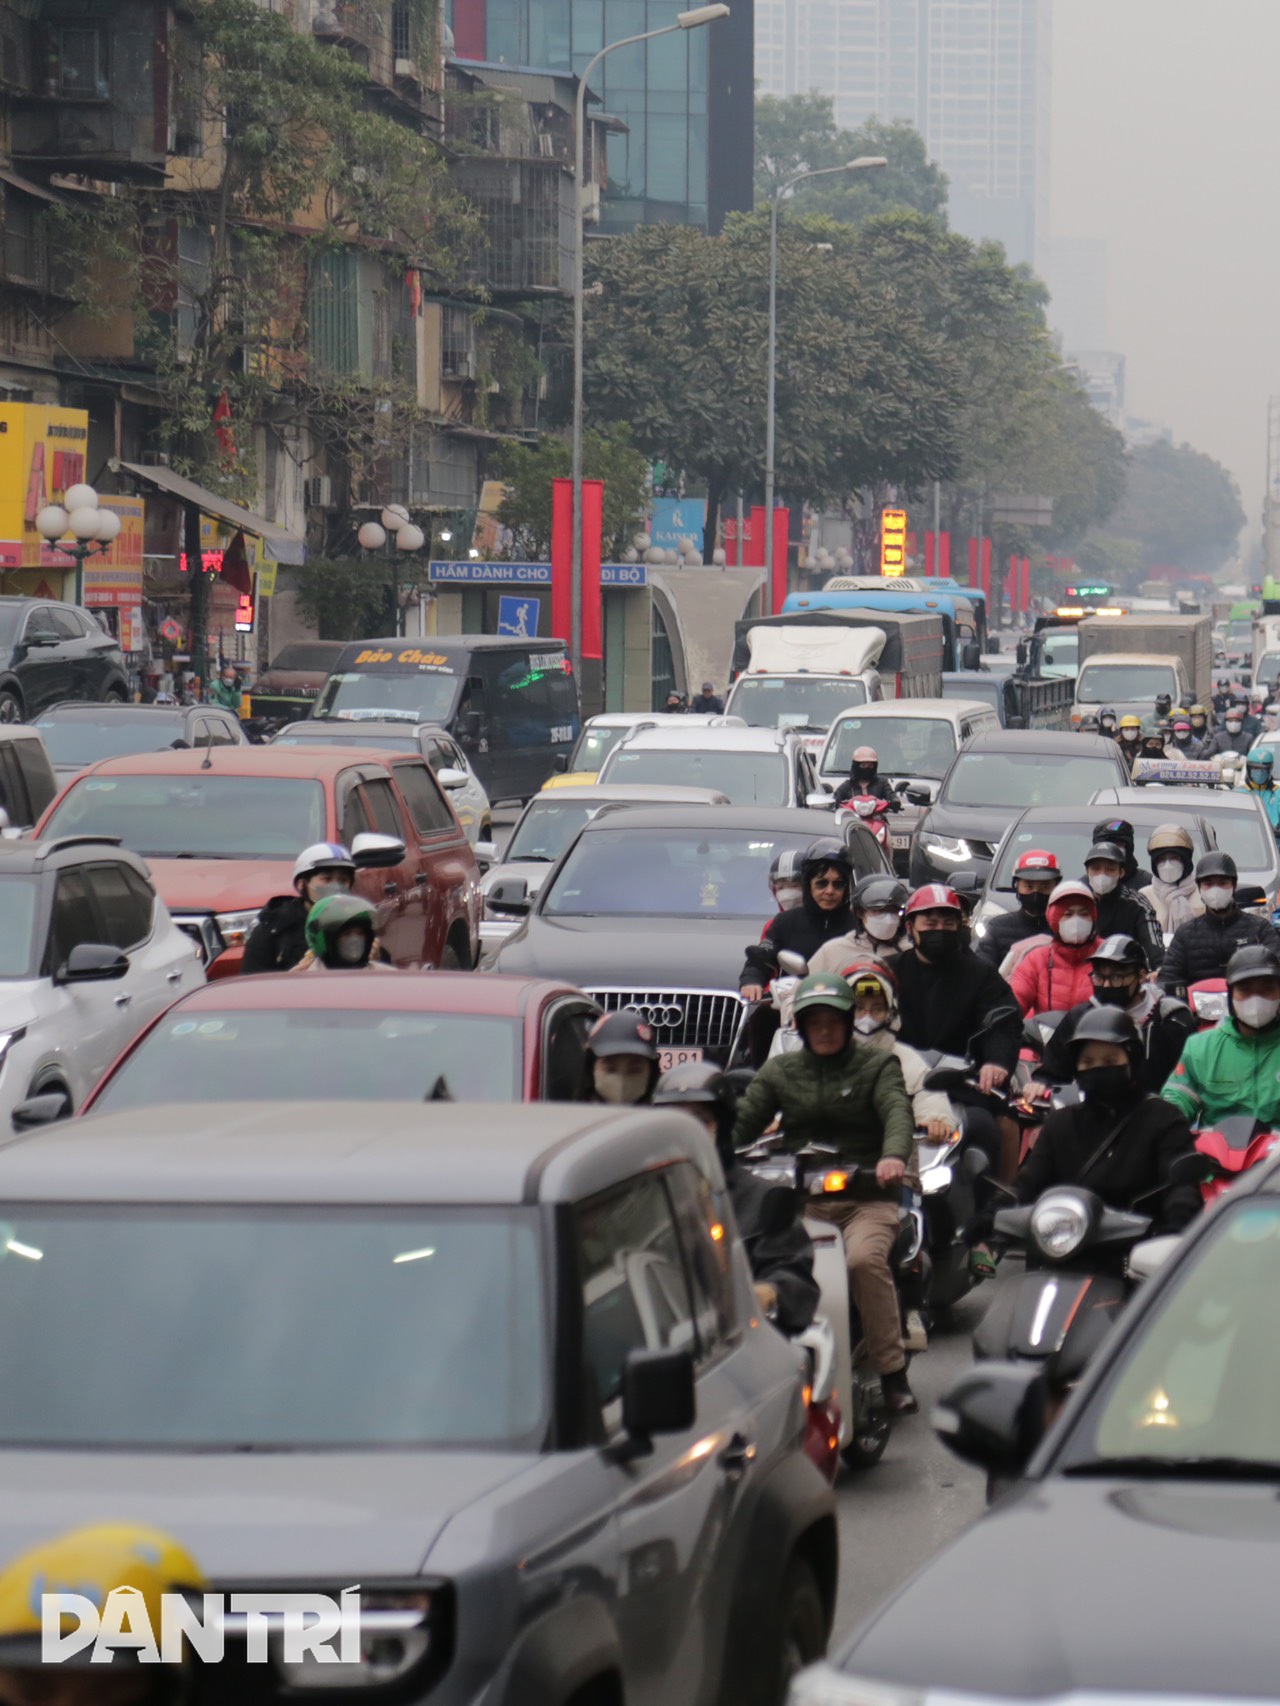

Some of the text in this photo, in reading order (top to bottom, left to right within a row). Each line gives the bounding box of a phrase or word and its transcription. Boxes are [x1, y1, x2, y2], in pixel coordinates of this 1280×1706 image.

[472, 565, 513, 580] DÀNH
[516, 568, 549, 580] CHO
[619, 567, 641, 584] BỘ
